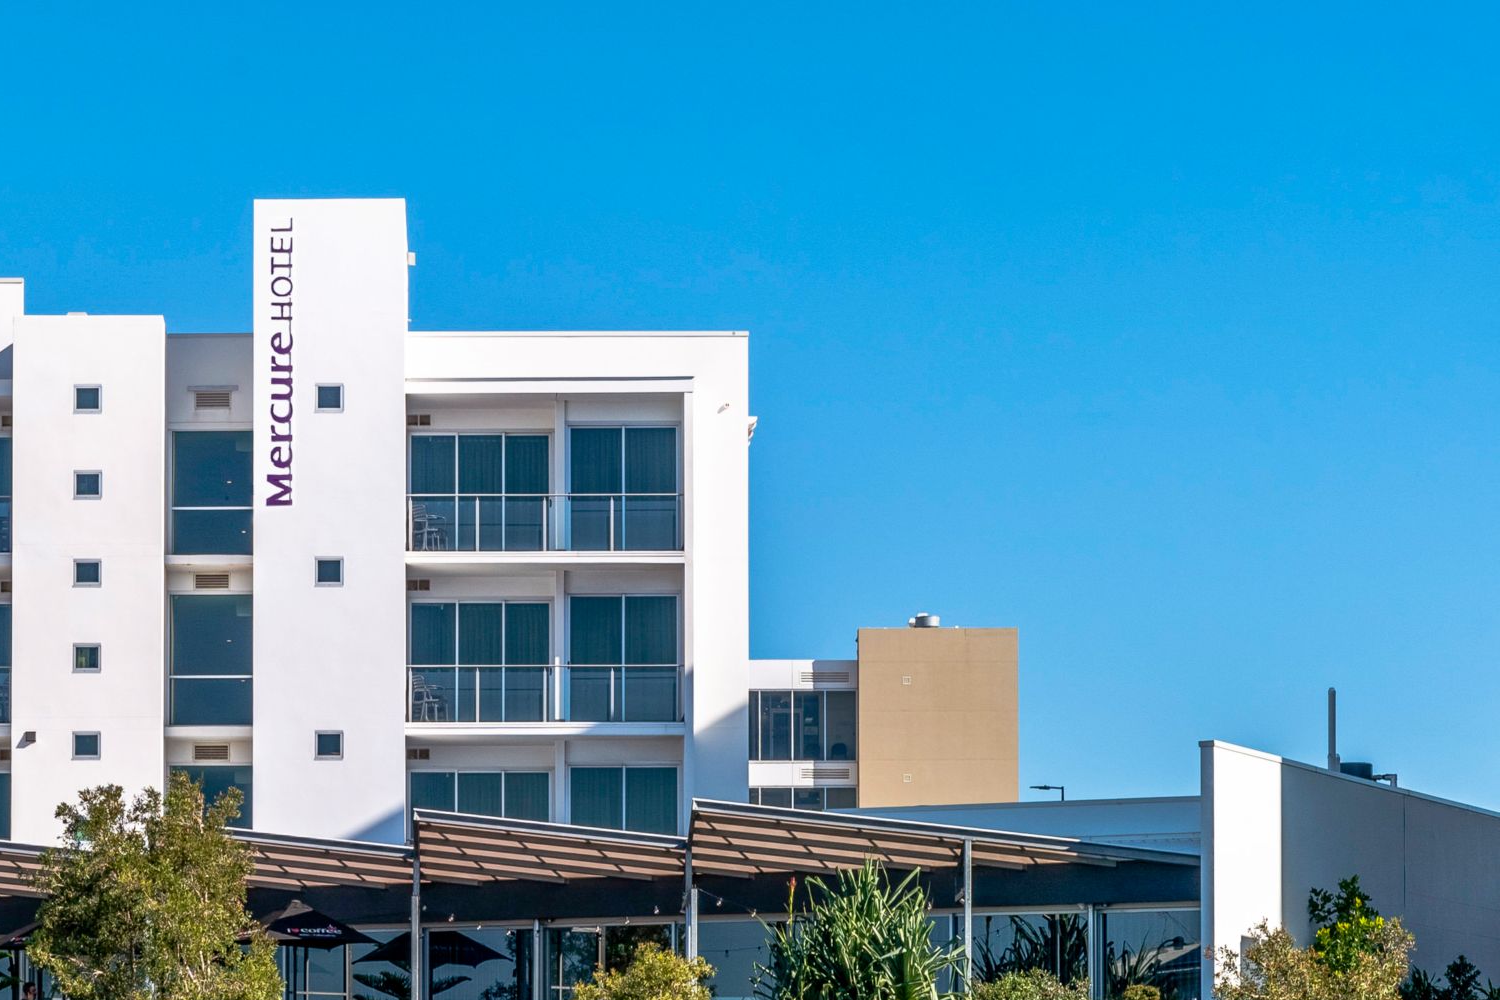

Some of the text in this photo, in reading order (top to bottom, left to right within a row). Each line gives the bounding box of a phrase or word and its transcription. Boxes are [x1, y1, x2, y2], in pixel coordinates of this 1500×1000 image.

[266, 217, 293, 506] Mercure HOTEL
[300, 927, 342, 935] coffee
